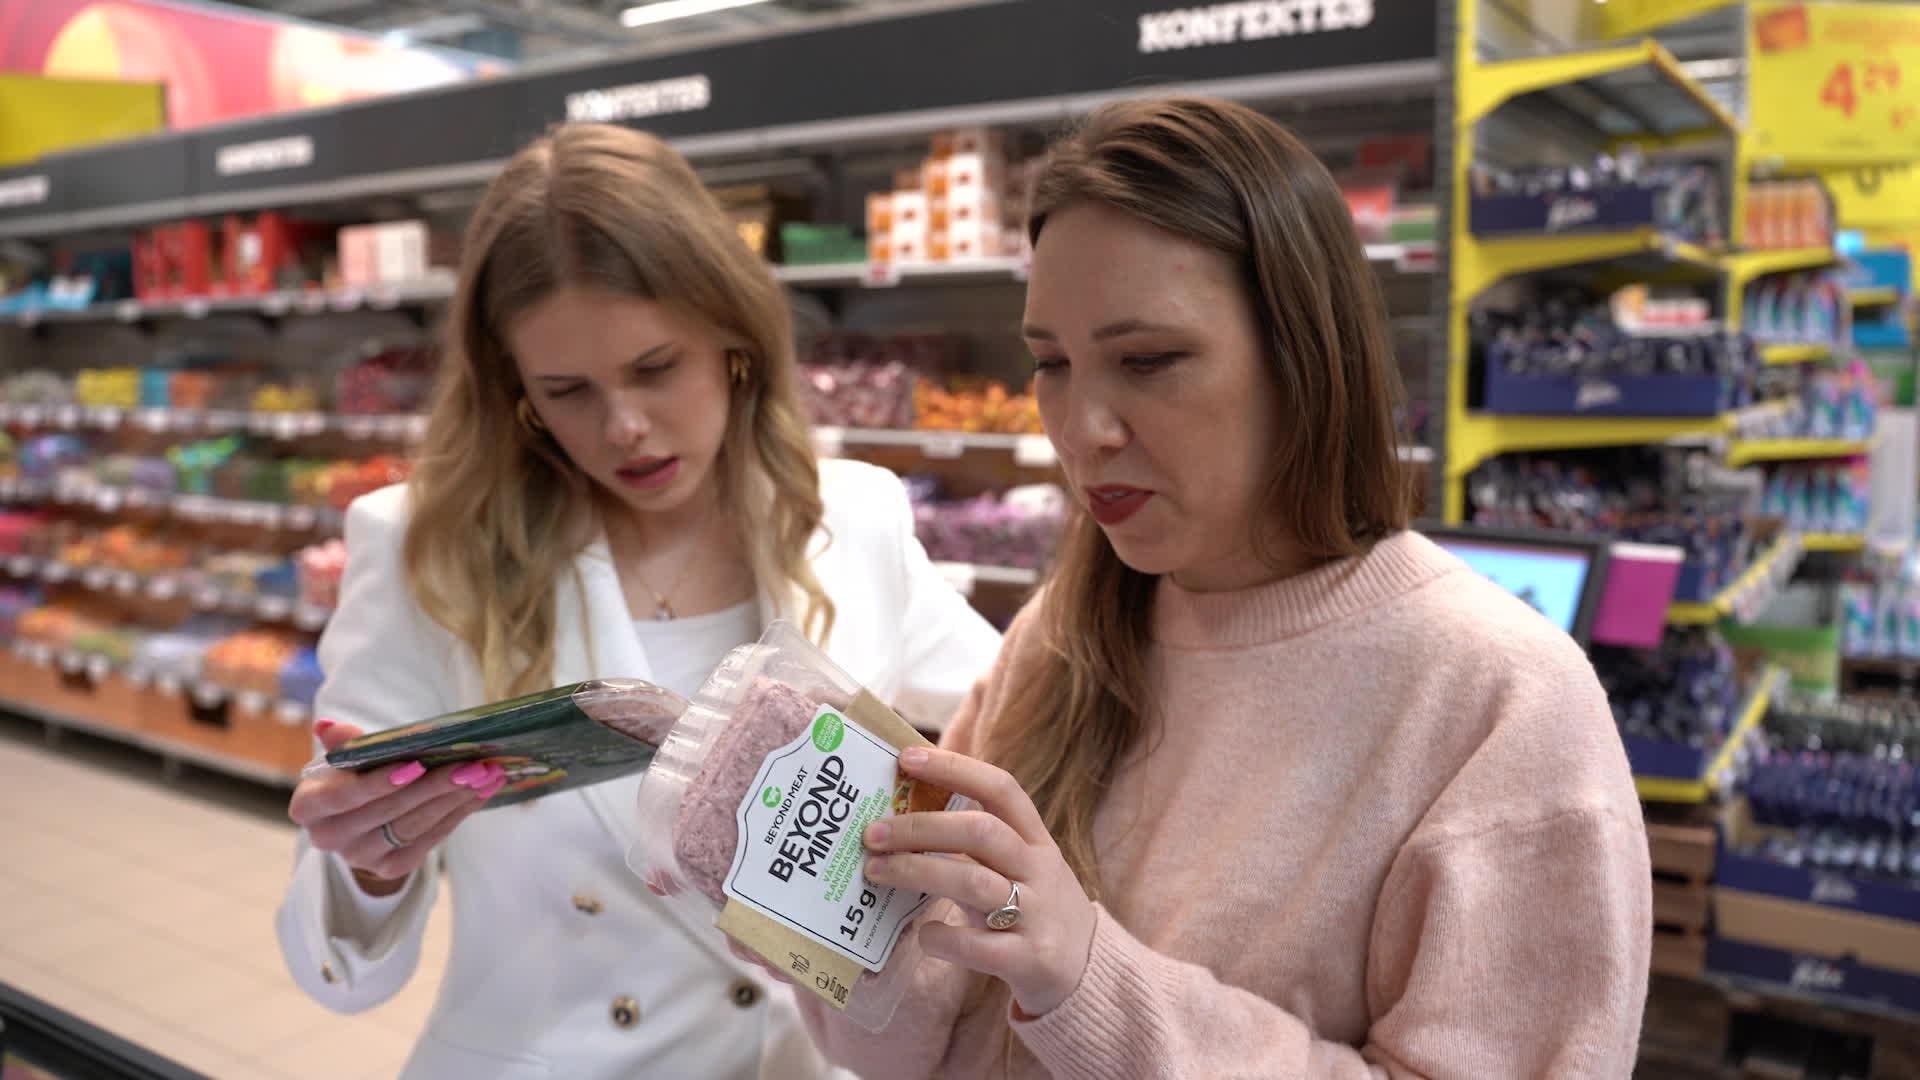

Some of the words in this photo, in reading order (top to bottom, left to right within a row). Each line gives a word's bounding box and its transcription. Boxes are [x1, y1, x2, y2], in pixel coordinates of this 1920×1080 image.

[1139, 0, 1374, 53] KONFEKTES
[1819, 62, 1858, 121] 4
[764, 798, 793, 845] BEYOND
[787, 767, 809, 799] MEAT
[768, 755, 845, 883] BEYOND
[798, 779, 860, 878] MINCE
[840, 905, 864, 941] 15
[860, 889, 877, 909] g
